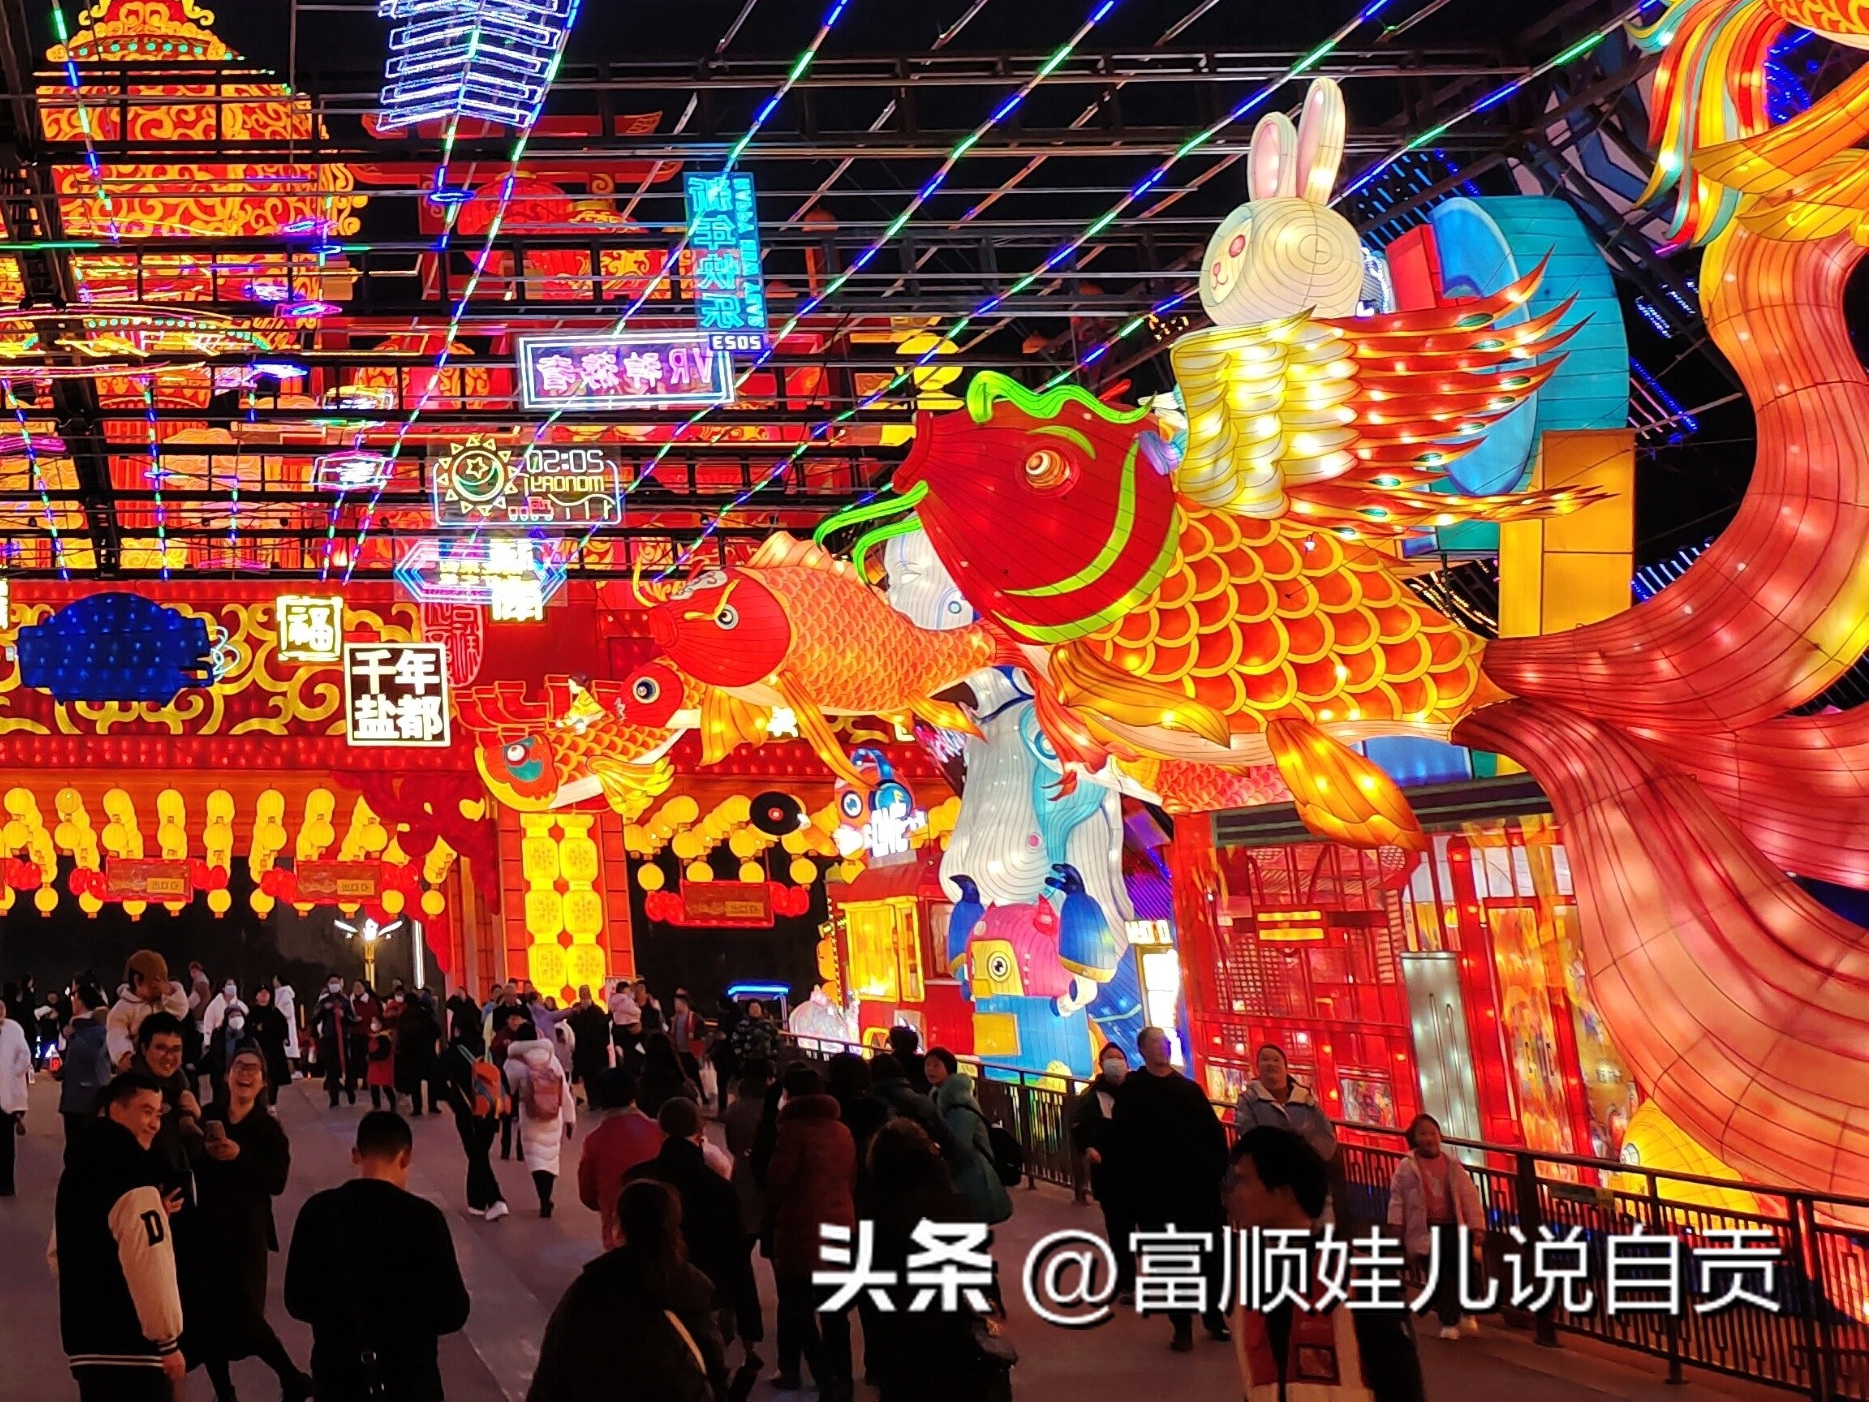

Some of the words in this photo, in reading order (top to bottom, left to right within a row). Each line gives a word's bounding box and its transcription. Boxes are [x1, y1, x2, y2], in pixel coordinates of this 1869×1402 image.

[286, 606, 334, 651] 福
[352, 649, 440, 695] 千年
[352, 694, 444, 741] 盐都
[139, 1209, 165, 1247] D
